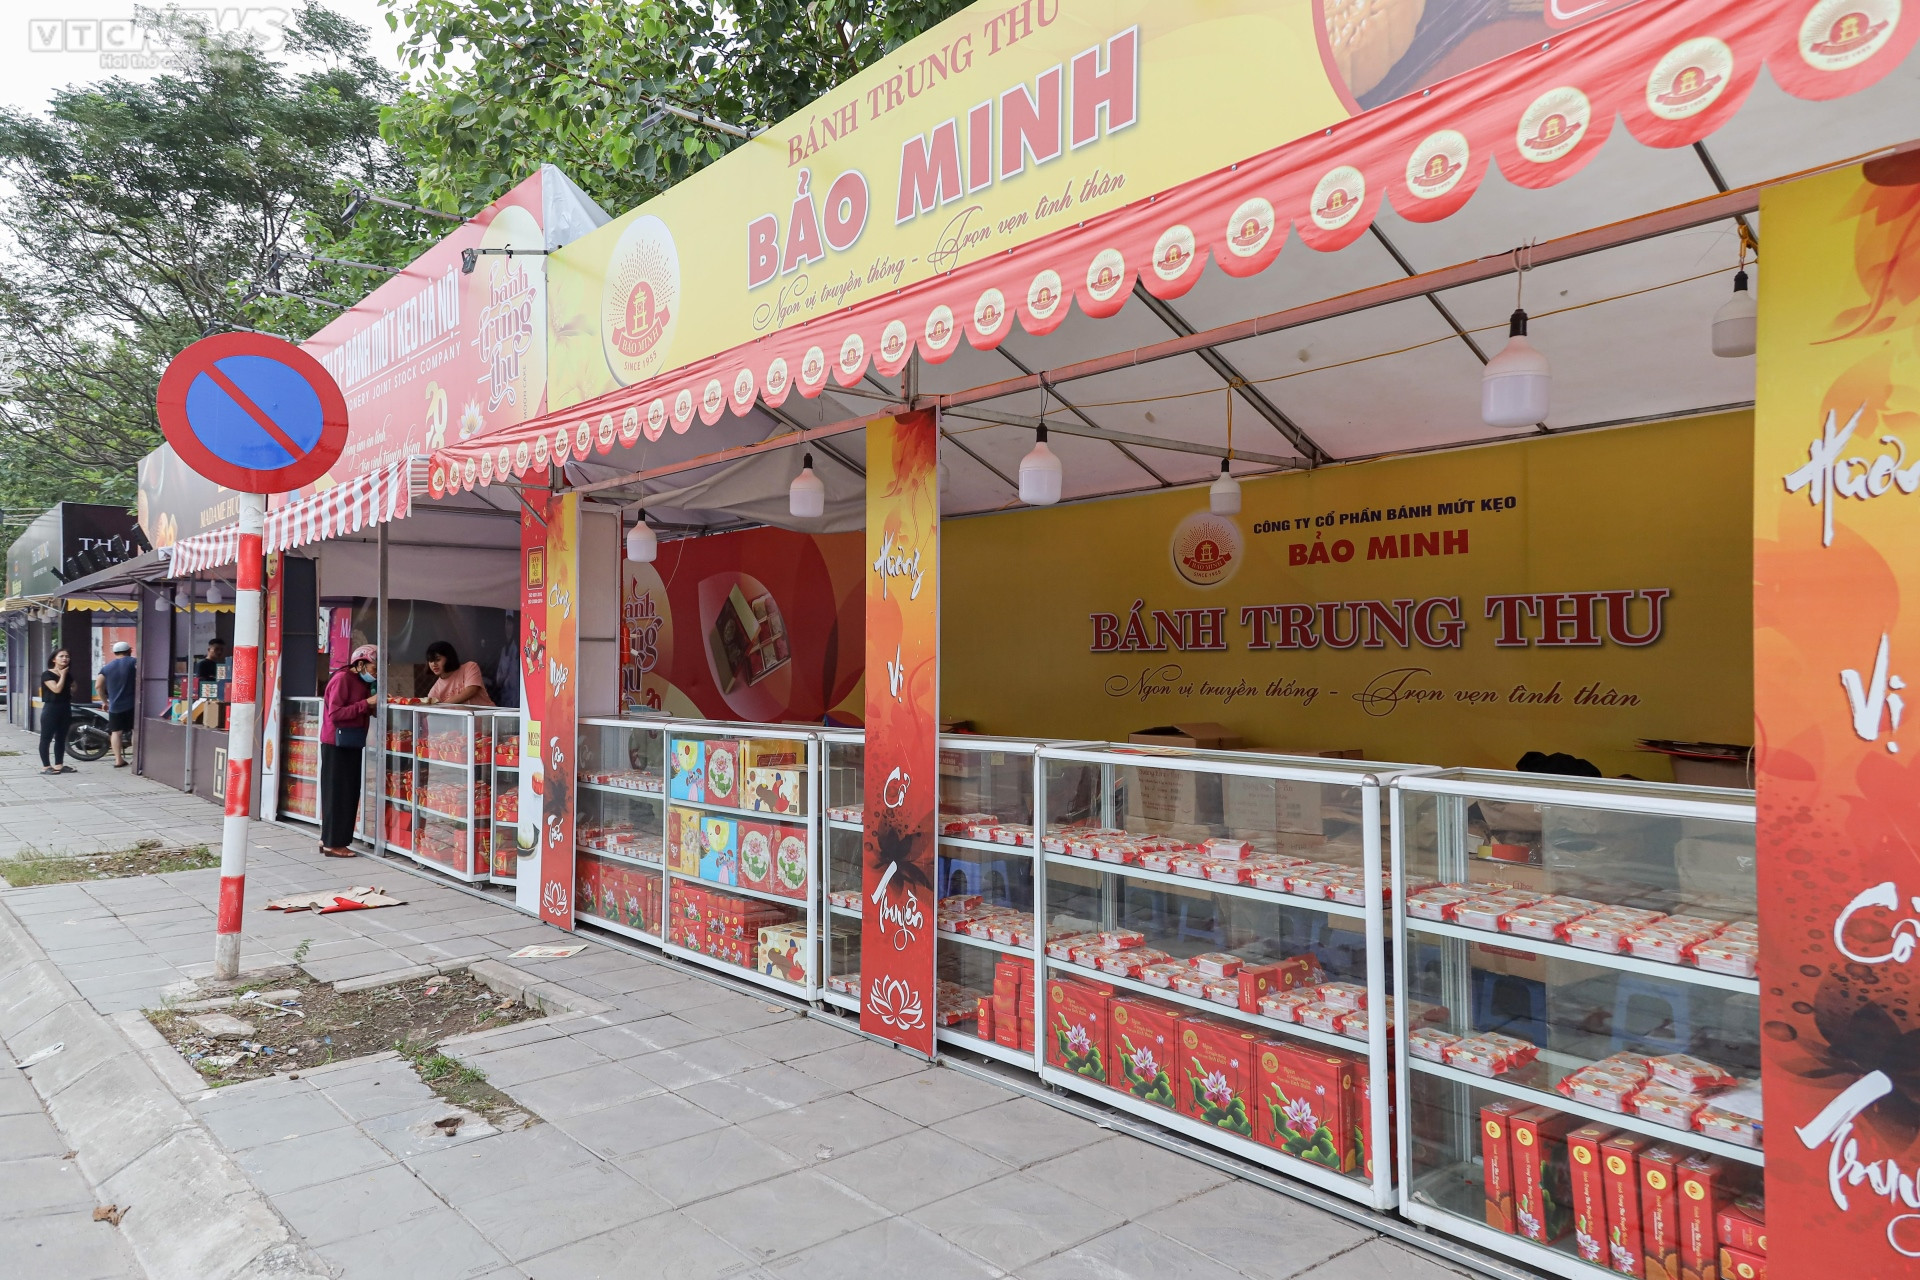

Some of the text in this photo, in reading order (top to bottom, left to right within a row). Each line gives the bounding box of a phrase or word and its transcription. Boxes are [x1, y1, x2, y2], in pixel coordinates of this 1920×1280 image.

[787, 99, 859, 168] BÁNH
[867, 33, 973, 121] TRUNG
[748, 25, 1139, 289] BẢO MINH
[753, 274, 809, 330] Ngon
[805, 291, 817, 310] vị
[820, 270, 863, 305] truyền
[867, 256, 906, 284] thống
[927, 206, 992, 274] Trọn
[997, 211, 1029, 234] vẹn
[1035, 181, 1074, 220] tình
[1079, 170, 1126, 203] thân
[624, 351, 658, 371] SINCE 1955
[638, 328, 659, 353] MINH
[372, 379, 392, 399] JOINT
[394, 365, 417, 388] STOCK
[420, 341, 461, 375] COMPANY
[1253, 496, 1517, 534] CÔNG TY CỔ PHẦN BÁNH MỨT KẸO
[1288, 529, 1470, 566] BẢO MINH
[1089, 588, 1670, 652] BÁNH TRUNG THU
[1105, 664, 1184, 703] Ngon
[1177, 683, 1195, 699] vị
[1200, 678, 1260, 705] truyền
[1265, 677, 1320, 707] thống
[1351, 667, 1447, 717] Trọn
[1453, 690, 1499, 706] vẹn
[1508, 681, 1563, 705] tình
[1573, 682, 1642, 707] thân
